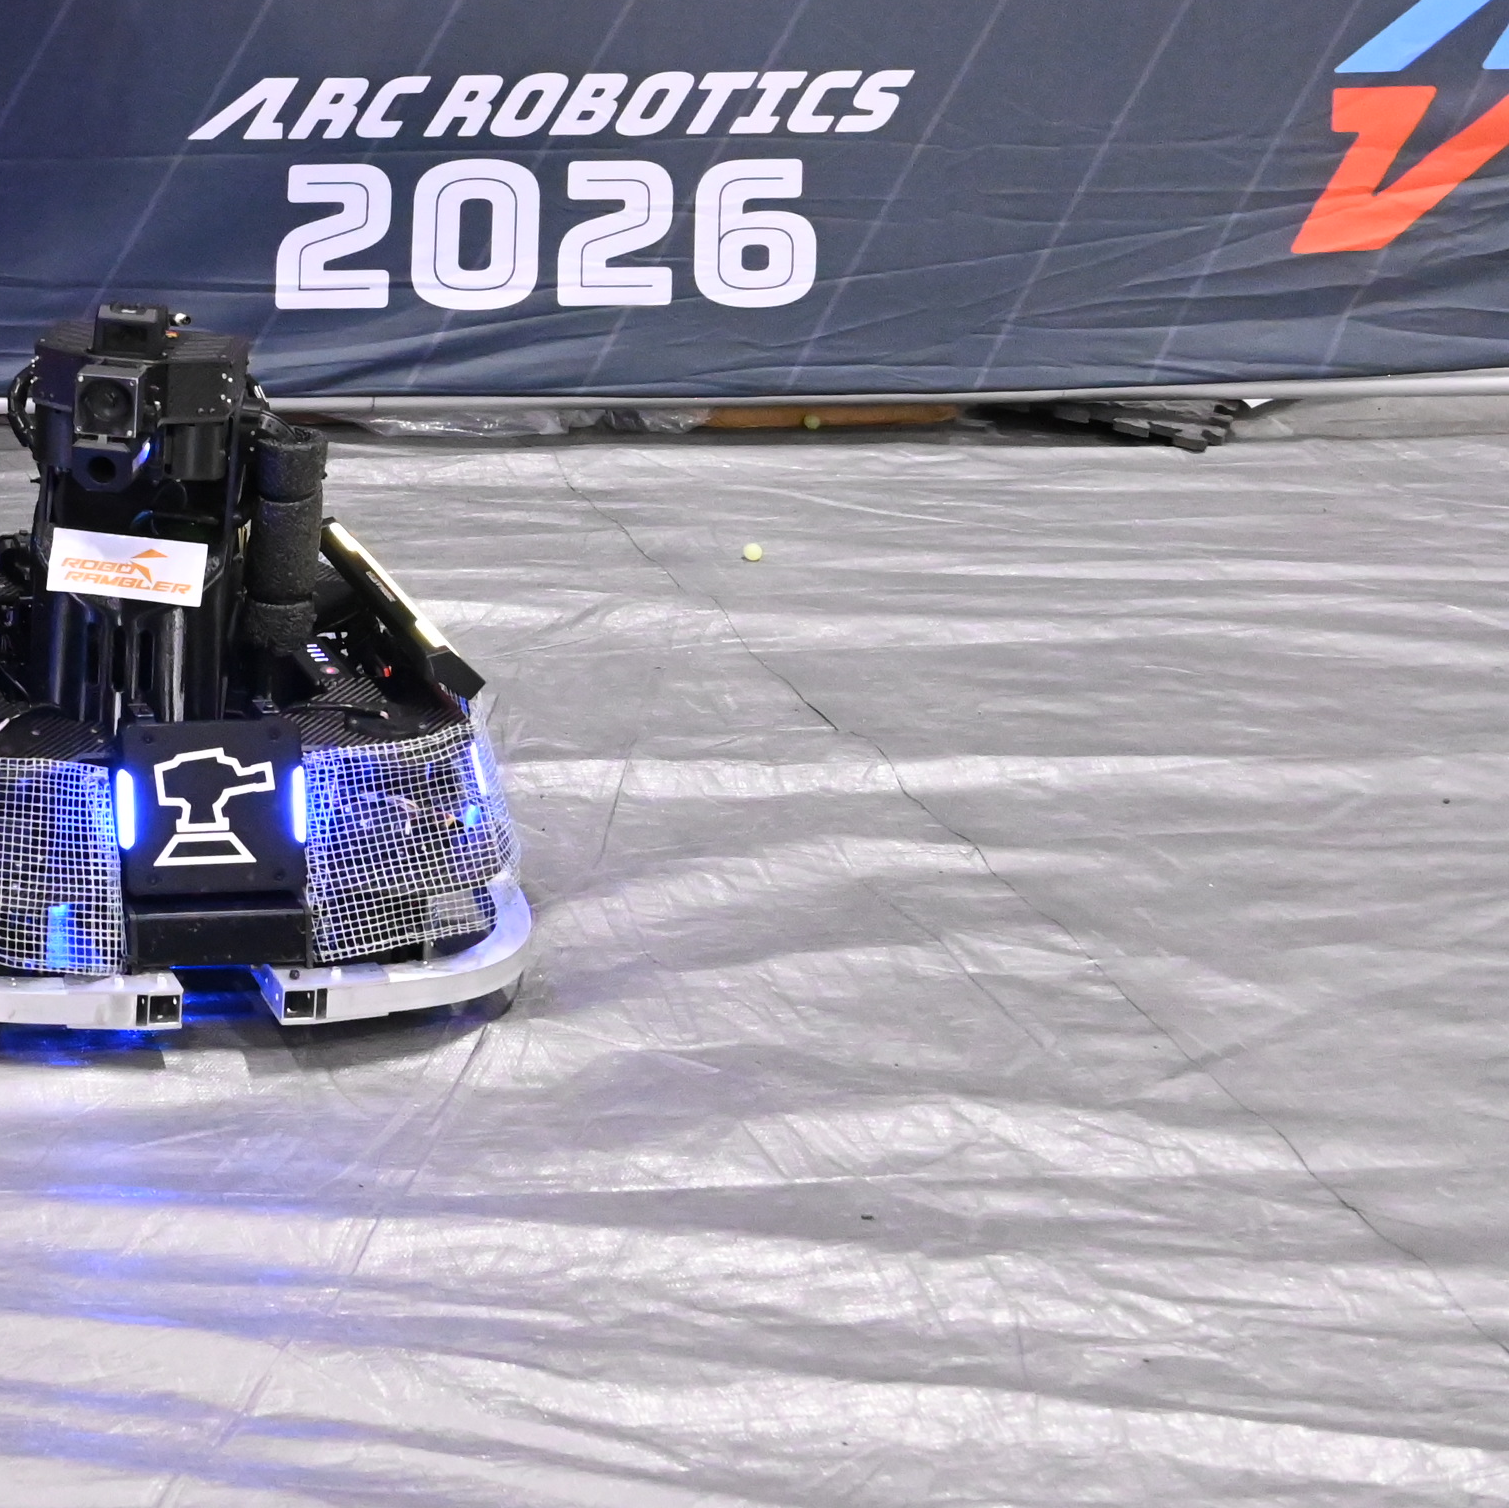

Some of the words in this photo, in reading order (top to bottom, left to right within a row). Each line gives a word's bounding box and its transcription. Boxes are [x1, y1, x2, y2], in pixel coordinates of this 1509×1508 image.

[188, 73, 431, 140] ARC
[424, 70, 916, 136] ROBOTICS
[274, 158, 817, 311] 2026
[61, 557, 136, 575] ROBO
[64, 571, 193, 595] RAMBLER
